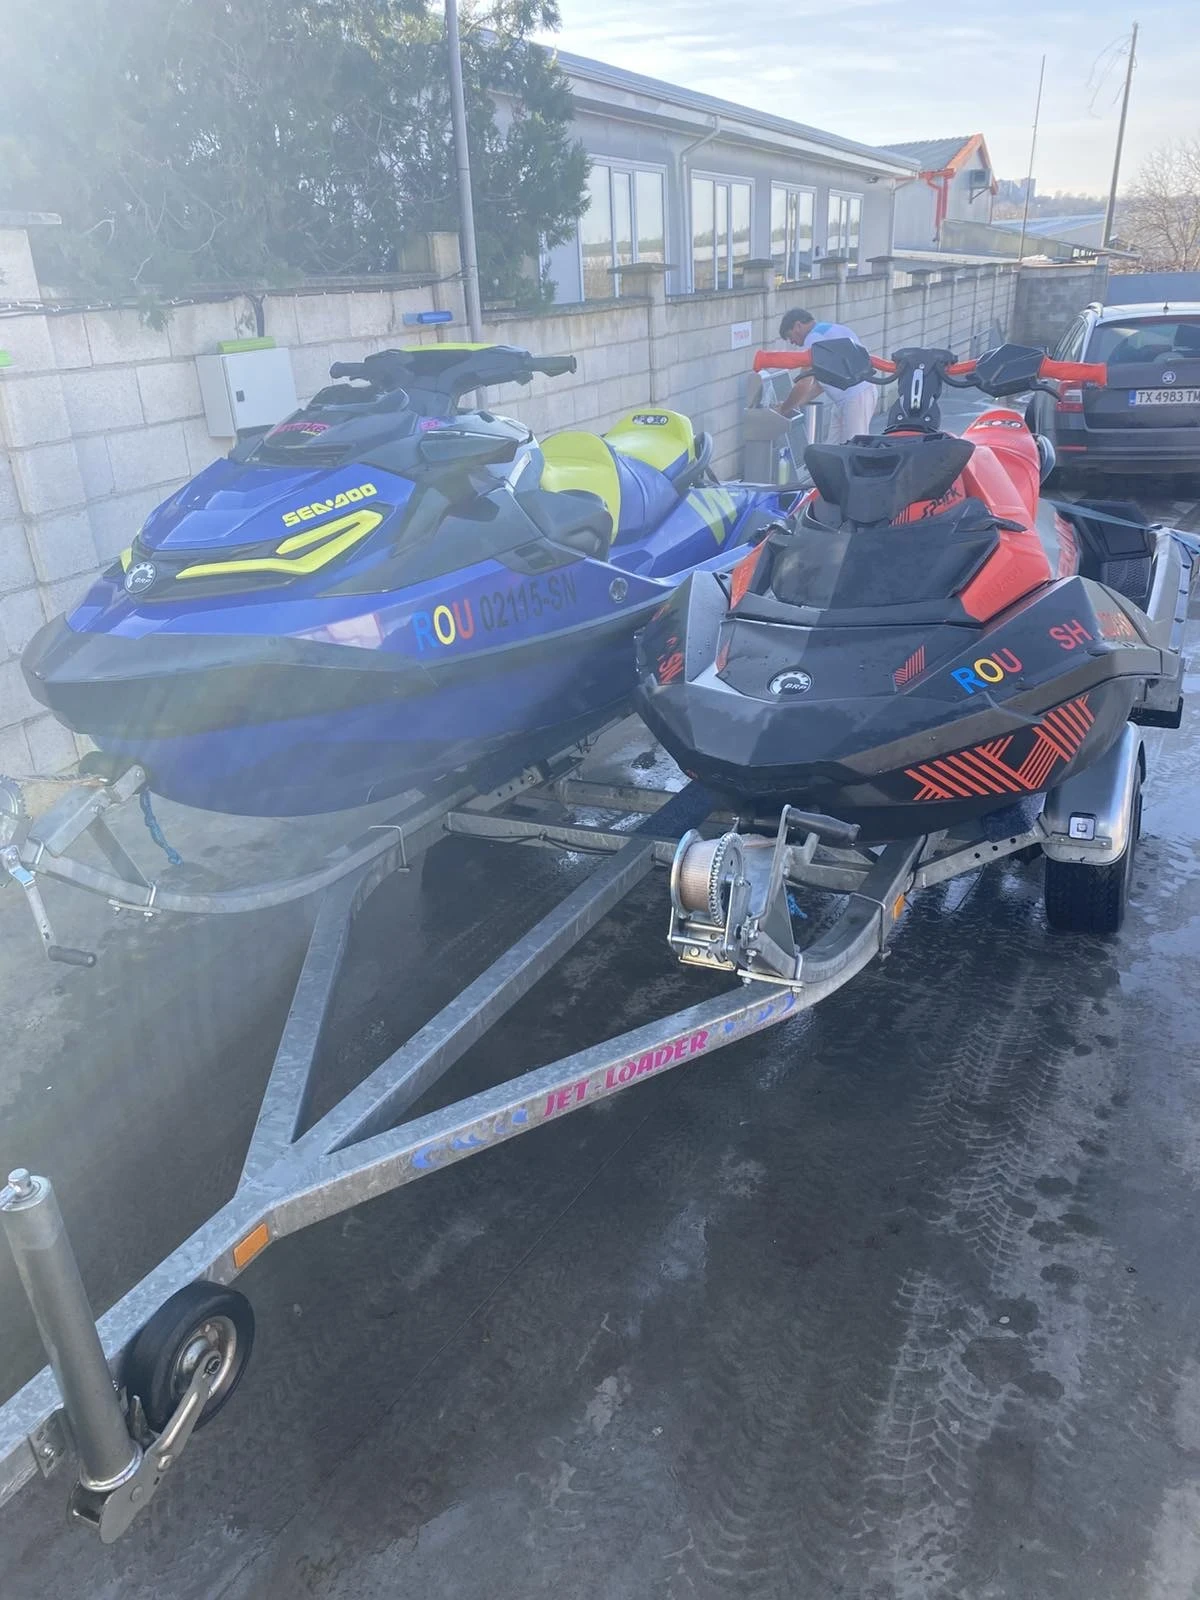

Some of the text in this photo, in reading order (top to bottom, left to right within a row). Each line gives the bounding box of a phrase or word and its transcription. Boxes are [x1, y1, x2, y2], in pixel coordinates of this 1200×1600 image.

[1138, 391, 1153, 403] TX
[1155, 391, 1184, 403] 4983
[411, 570, 578, 652] ROU 02115-SN
[950, 647, 1023, 695] ROU
[1049, 619, 1094, 650] SH
[544, 1077, 589, 1117] JET
[605, 1029, 709, 1089] LOADER
